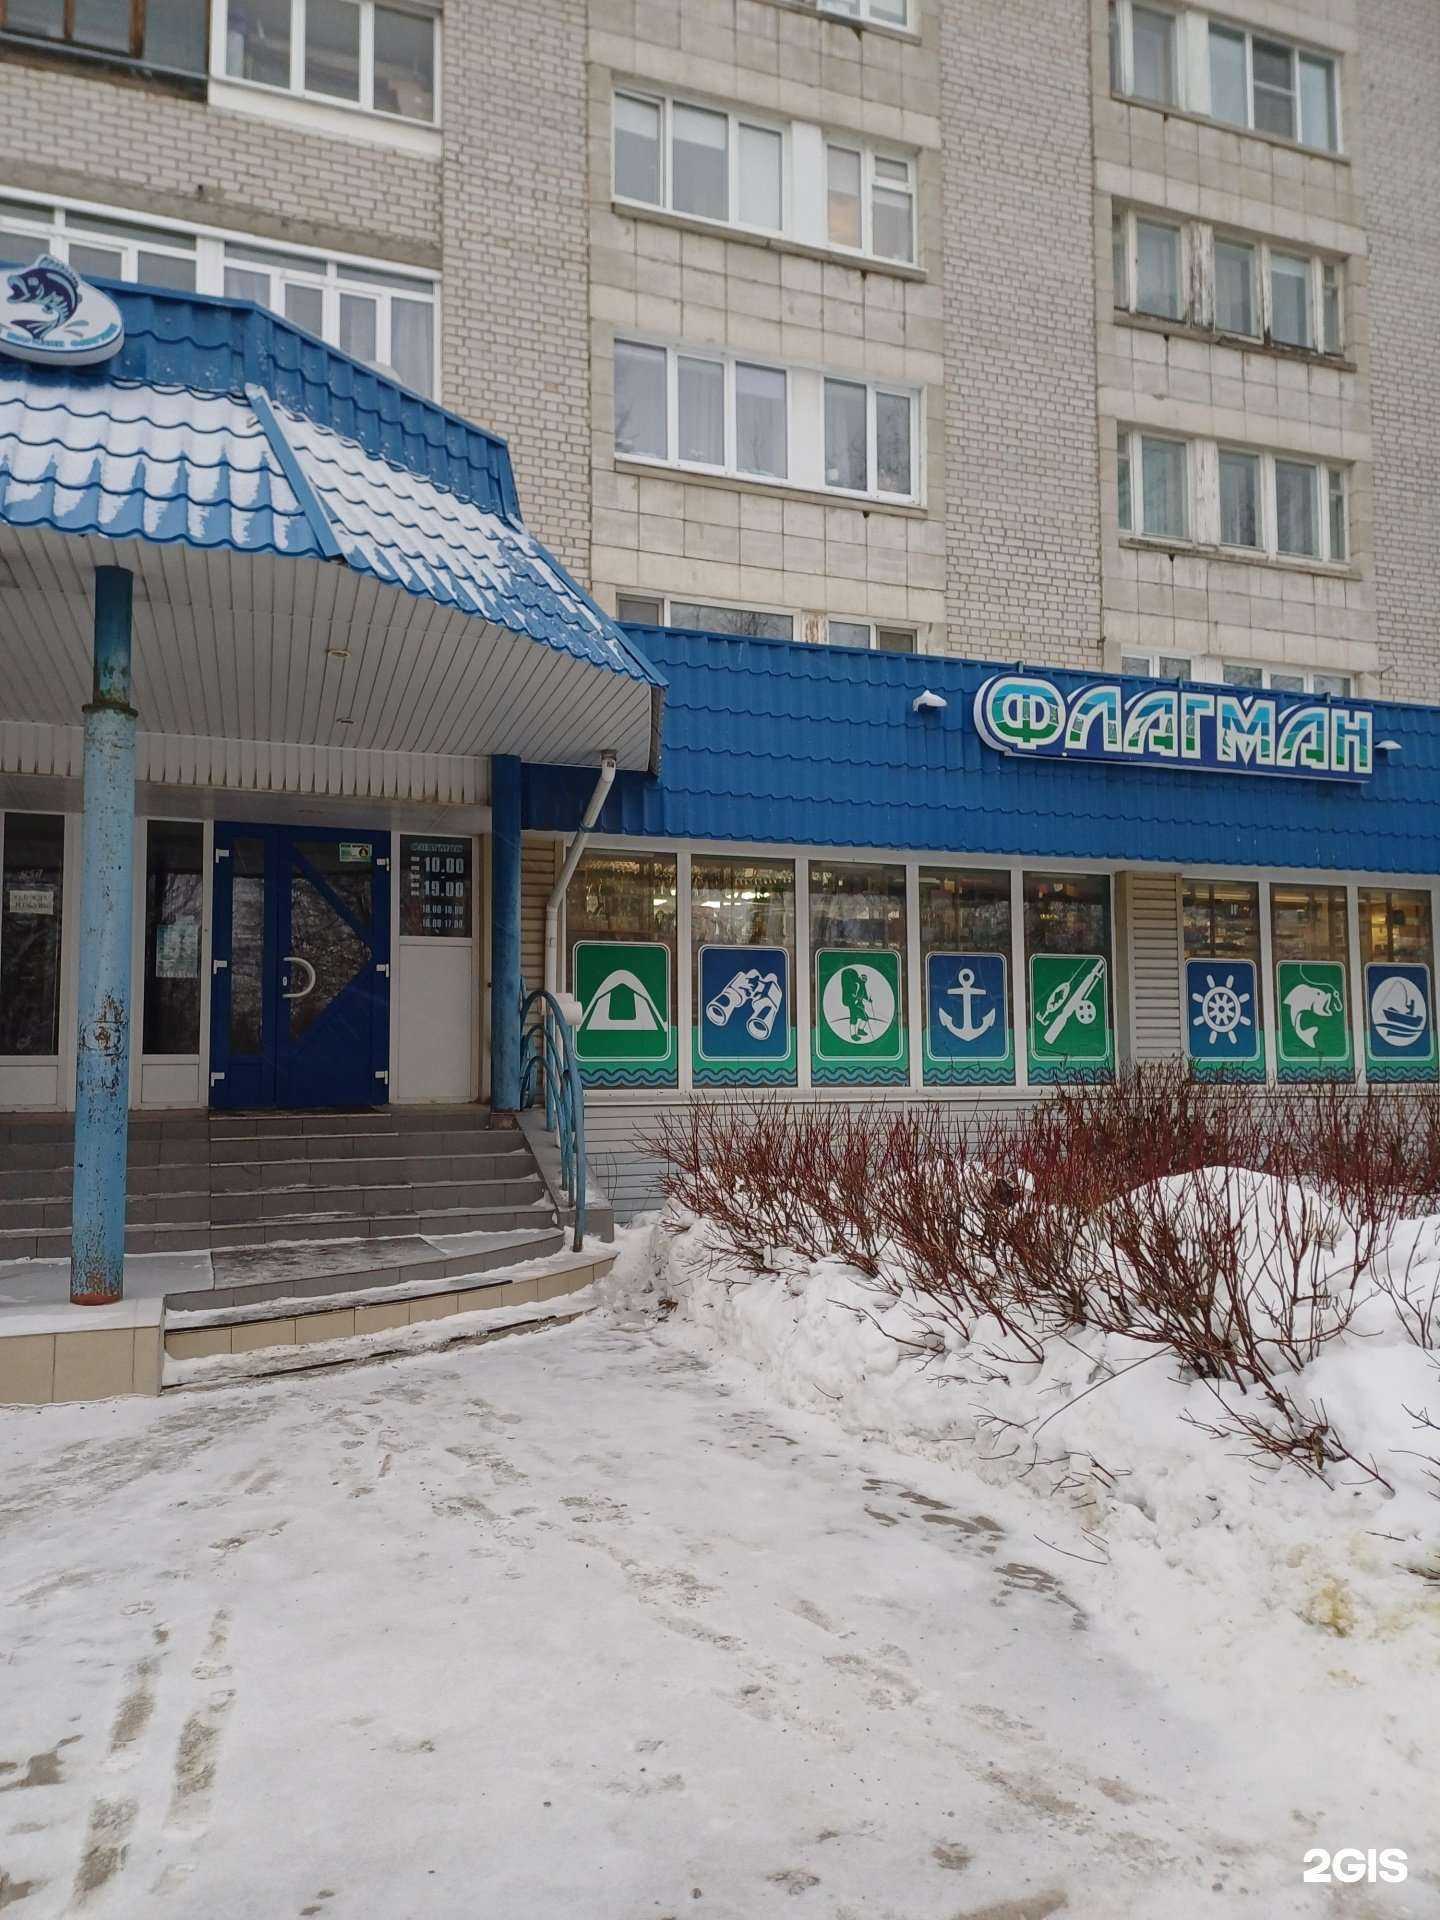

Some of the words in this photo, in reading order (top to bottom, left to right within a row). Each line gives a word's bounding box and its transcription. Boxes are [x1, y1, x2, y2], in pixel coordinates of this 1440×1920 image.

[984, 676, 1373, 774] ФЛАГМАН
[424, 856, 464, 874] 10.00
[424, 880, 464, 897] 19.00
